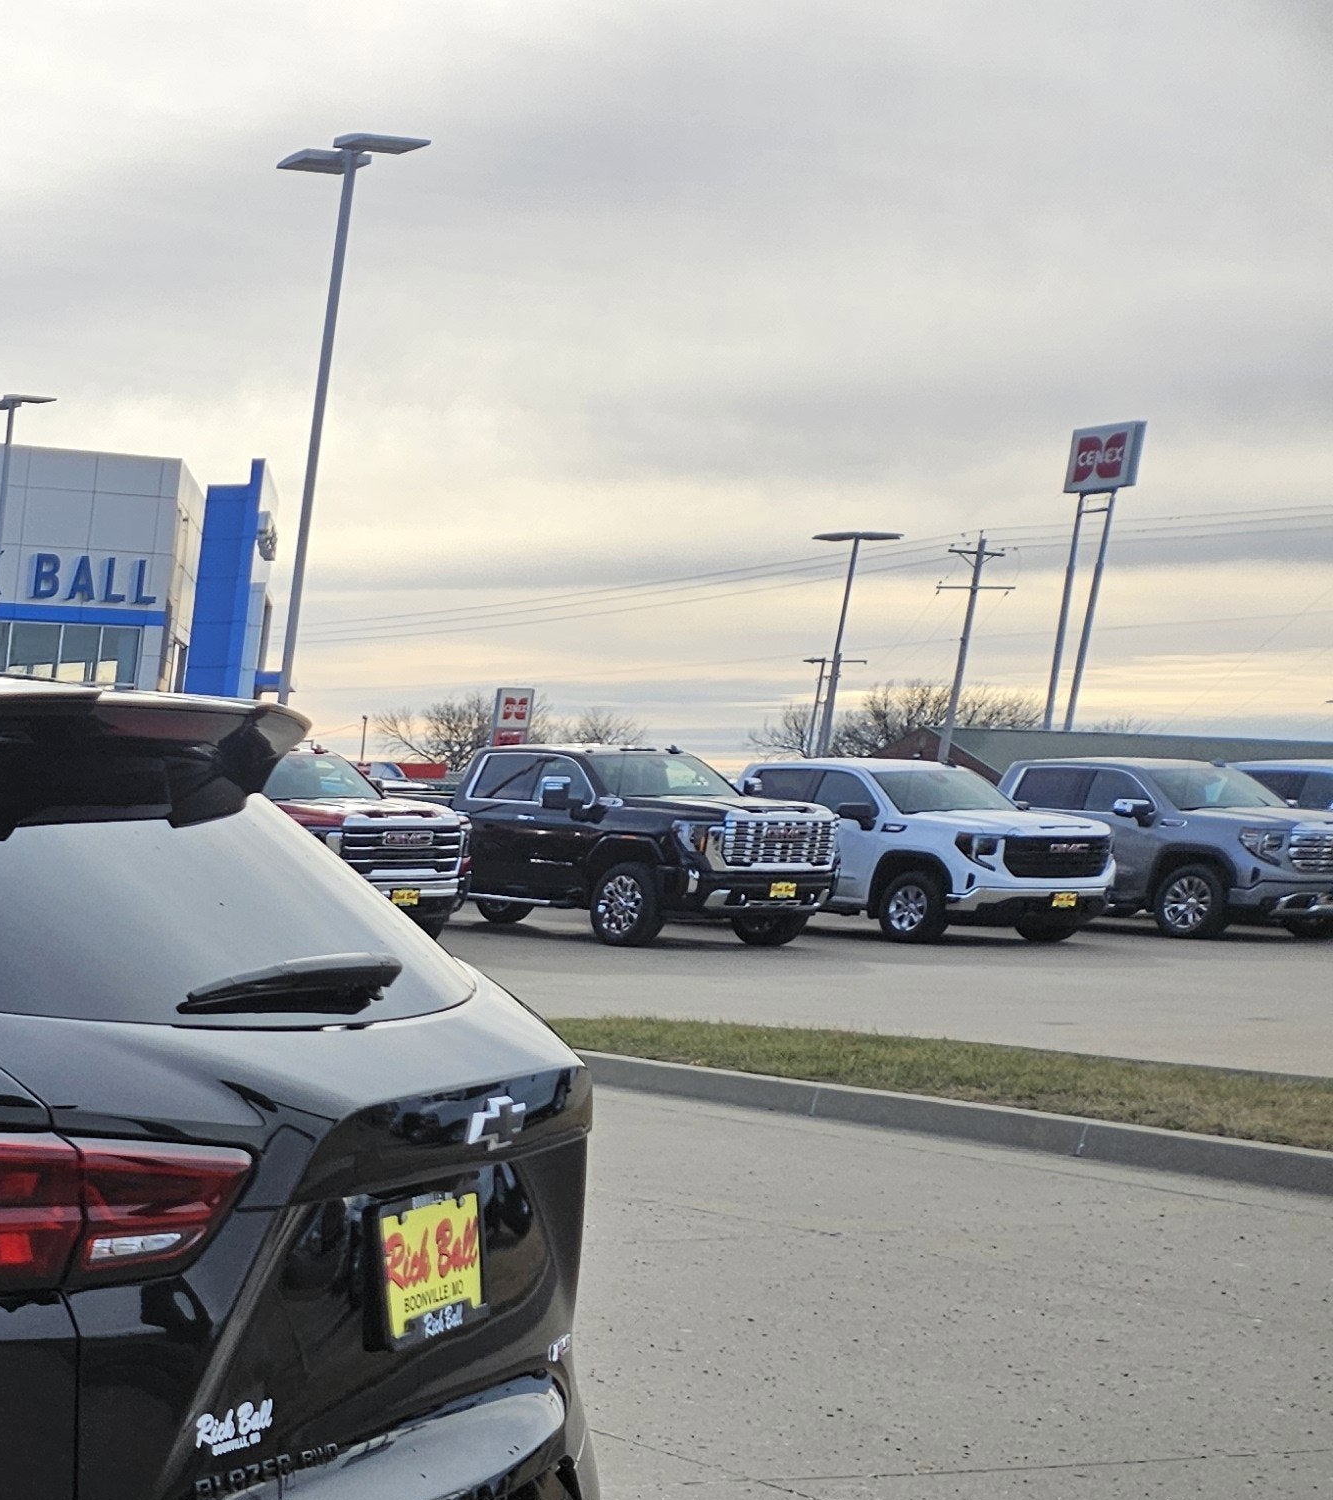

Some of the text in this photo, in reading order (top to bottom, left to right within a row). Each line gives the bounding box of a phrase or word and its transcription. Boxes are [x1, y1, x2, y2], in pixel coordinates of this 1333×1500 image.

[1077, 445, 1125, 466] CENEX
[31, 552, 157, 604] BALL
[384, 1216, 479, 1290] Rick Ball
[451, 1279, 464, 1296] MO
[195, 1398, 273, 1449] Rick Ball
